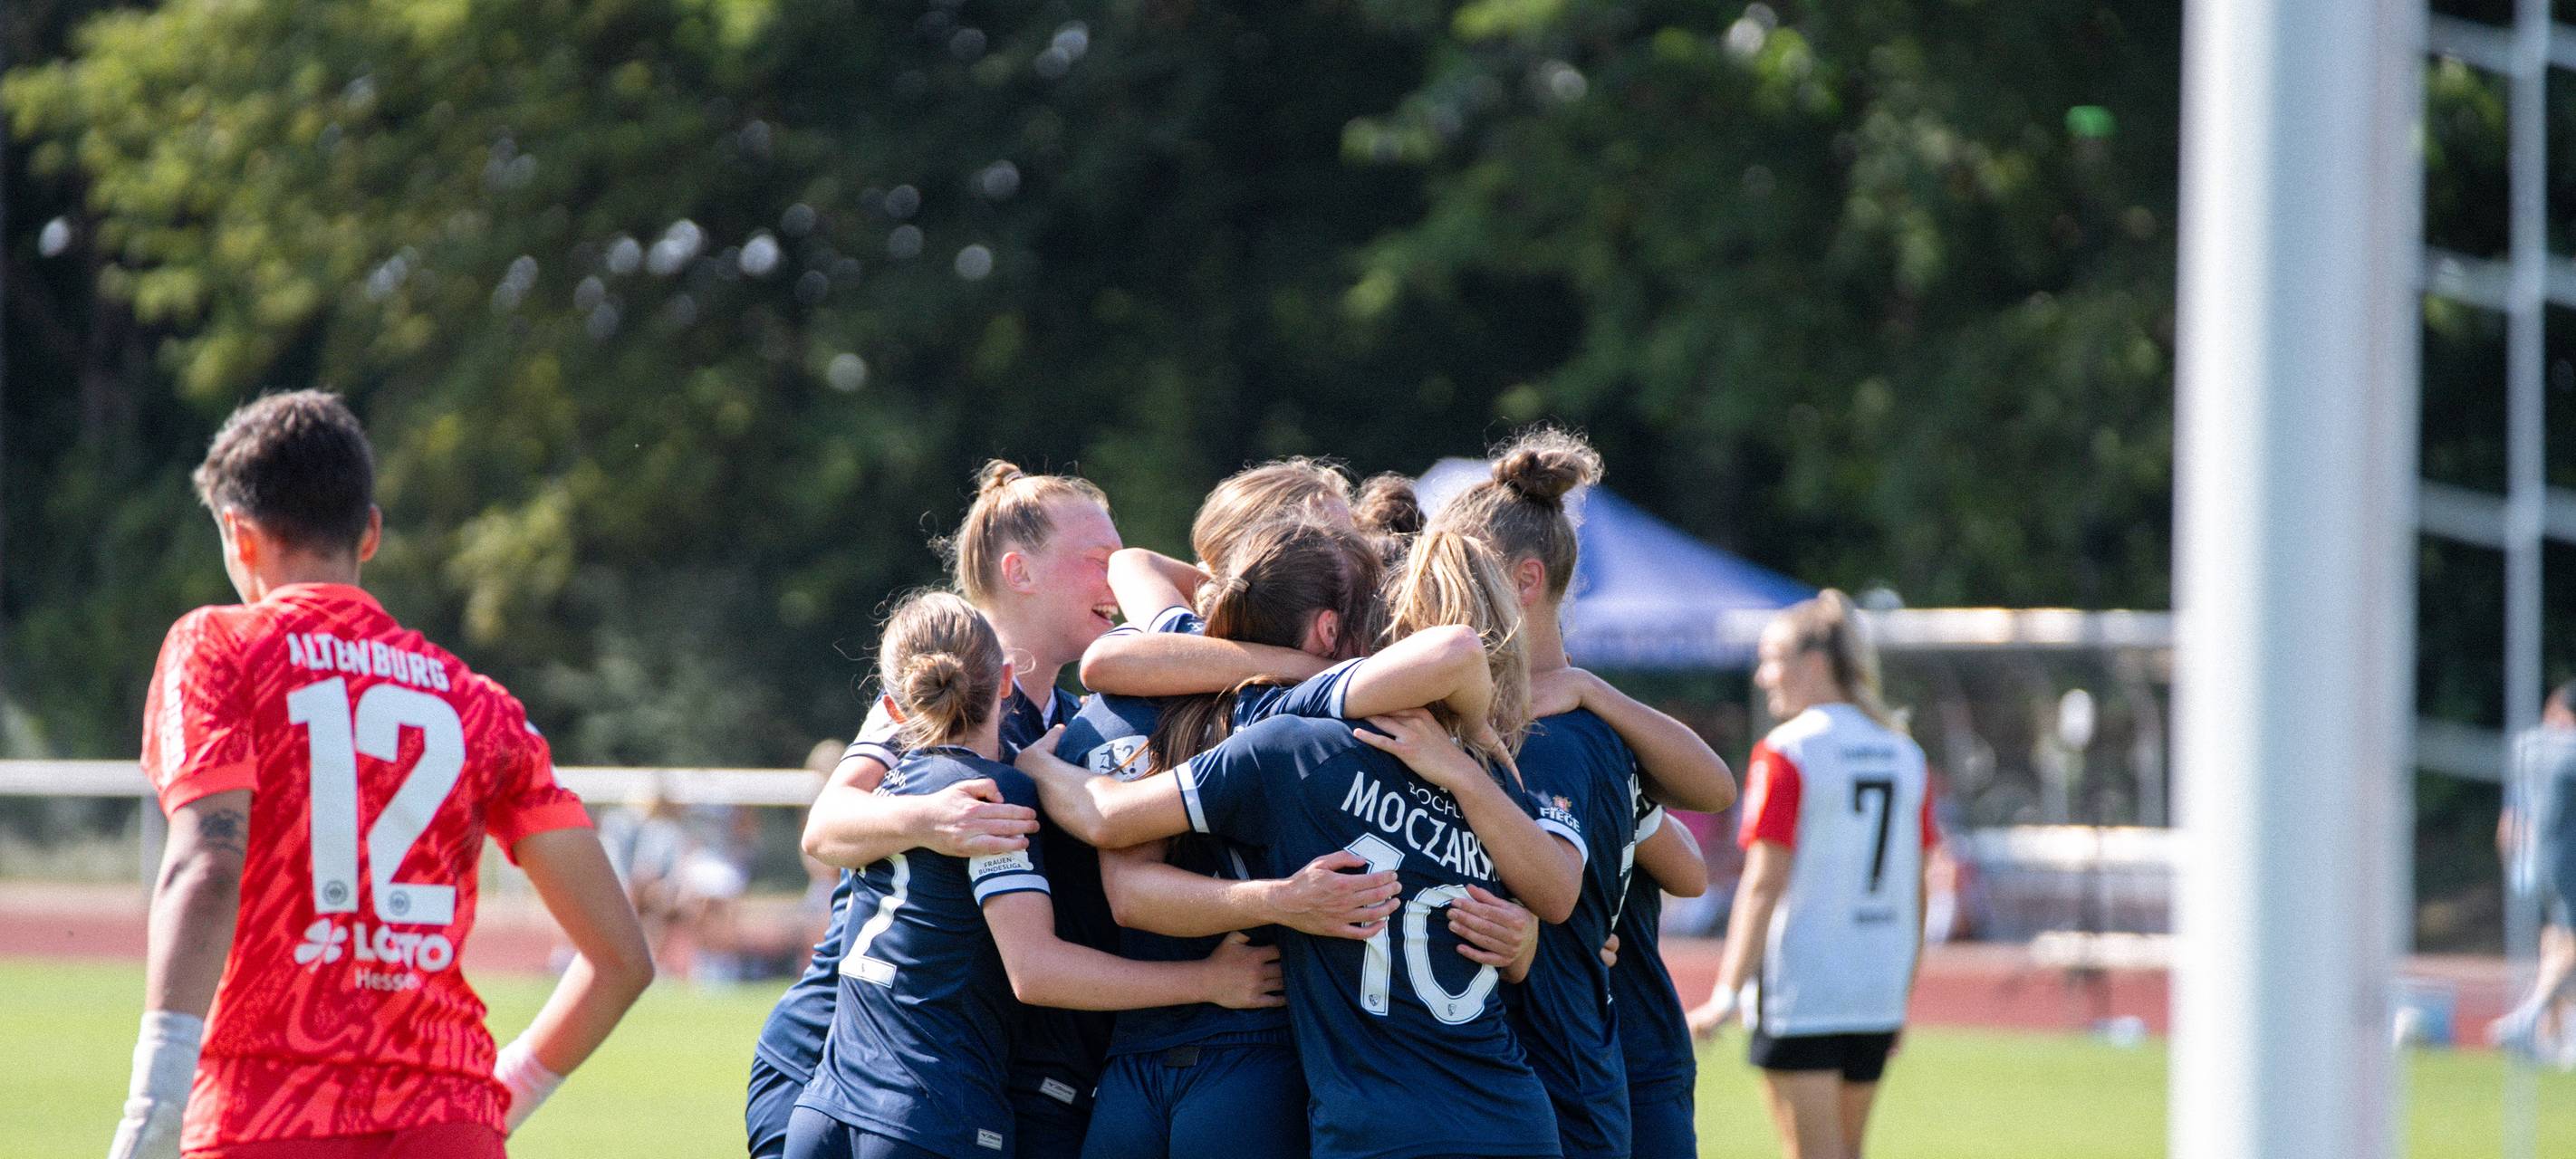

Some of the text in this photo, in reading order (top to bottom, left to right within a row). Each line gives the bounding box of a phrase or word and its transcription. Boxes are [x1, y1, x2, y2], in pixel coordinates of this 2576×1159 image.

[286, 632, 450, 692] ALTENBURG
[286, 675, 466, 925] 12
[1540, 806, 1581, 833] FIEGE
[1852, 777, 1894, 895] 7
[1344, 831, 1499, 1025] 10
